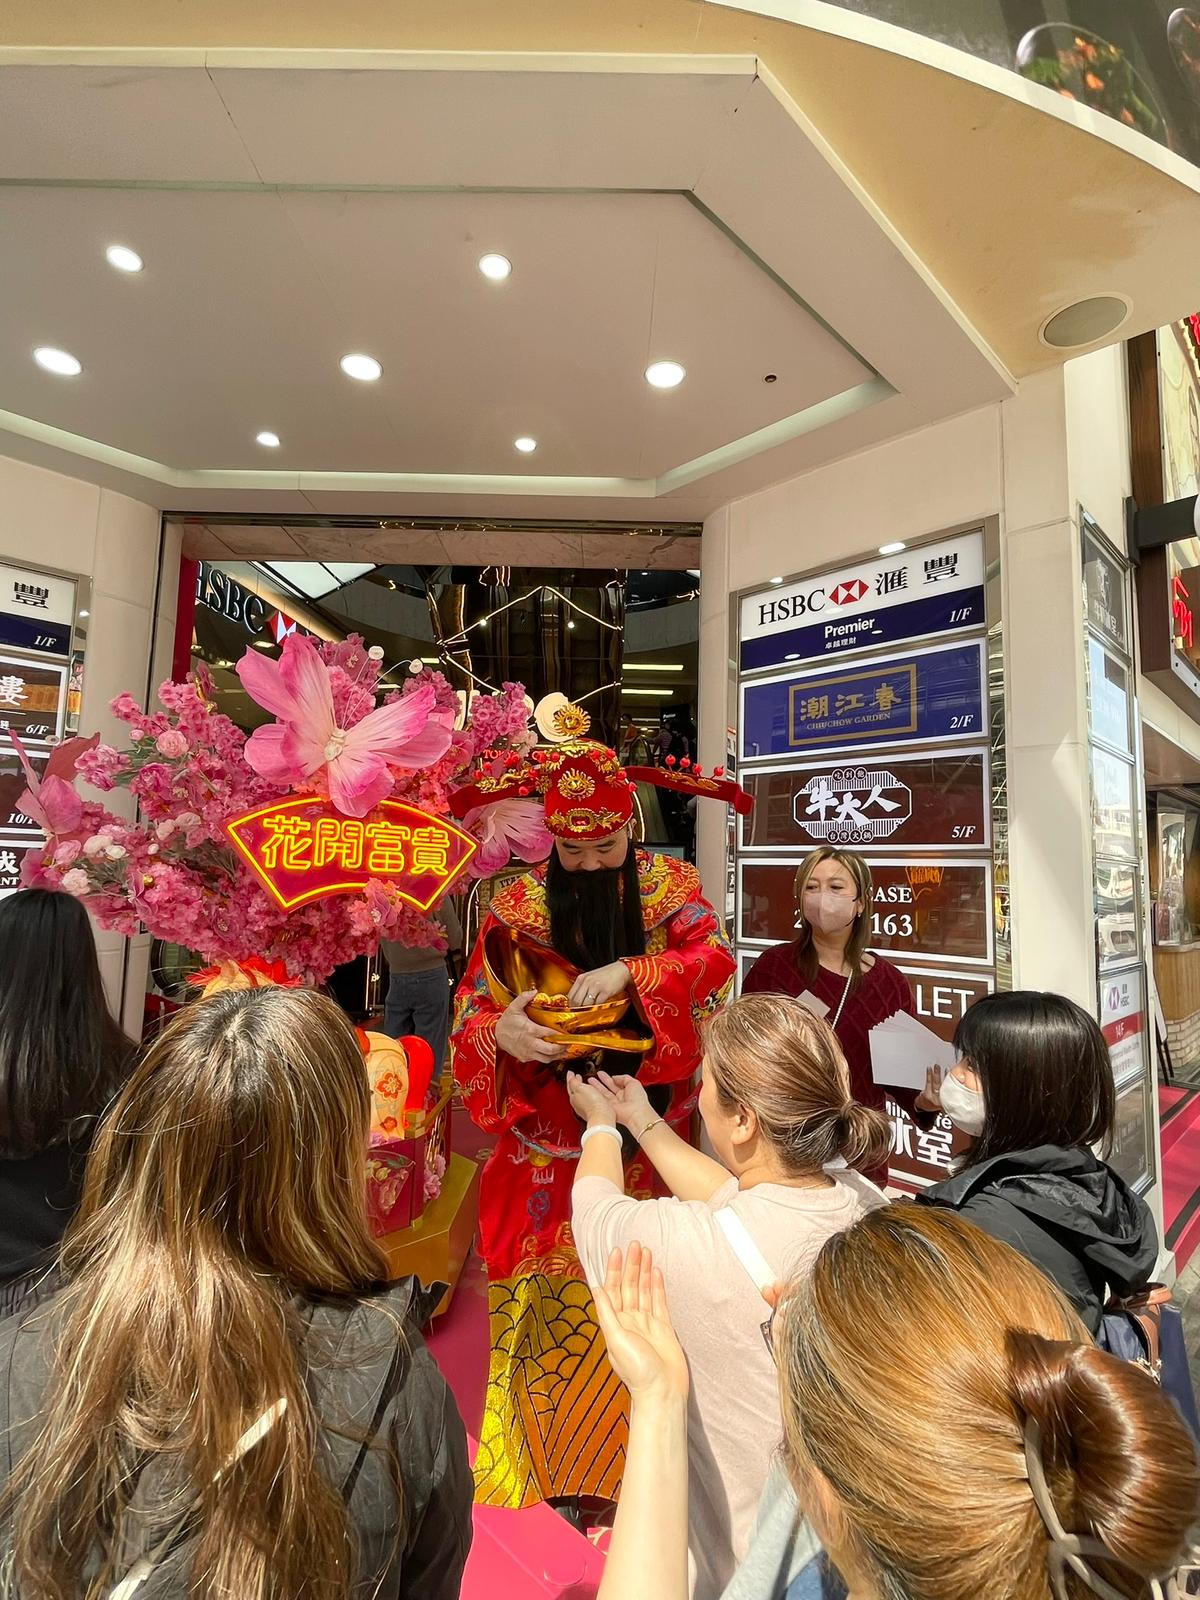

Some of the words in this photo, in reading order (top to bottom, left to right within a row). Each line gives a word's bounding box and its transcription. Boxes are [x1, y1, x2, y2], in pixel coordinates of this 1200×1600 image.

[12, 581, 49, 609] 豐
[758, 588, 826, 626] HSBC
[949, 607, 972, 623] 1/F
[824, 618, 875, 639] Premier
[34, 635, 57, 647] 1/F
[800, 682, 902, 721] 潮江春
[854, 711, 891, 724] GARDEN
[949, 714, 974, 729] 2/F
[25, 724, 50, 735] 6/F
[805, 779, 902, 828] 牛大人
[951, 825, 976, 838] 5/F
[261, 815, 451, 876] 花開富貴
[870, 886, 913, 903] ASE
[916, 984, 975, 1019] LET
